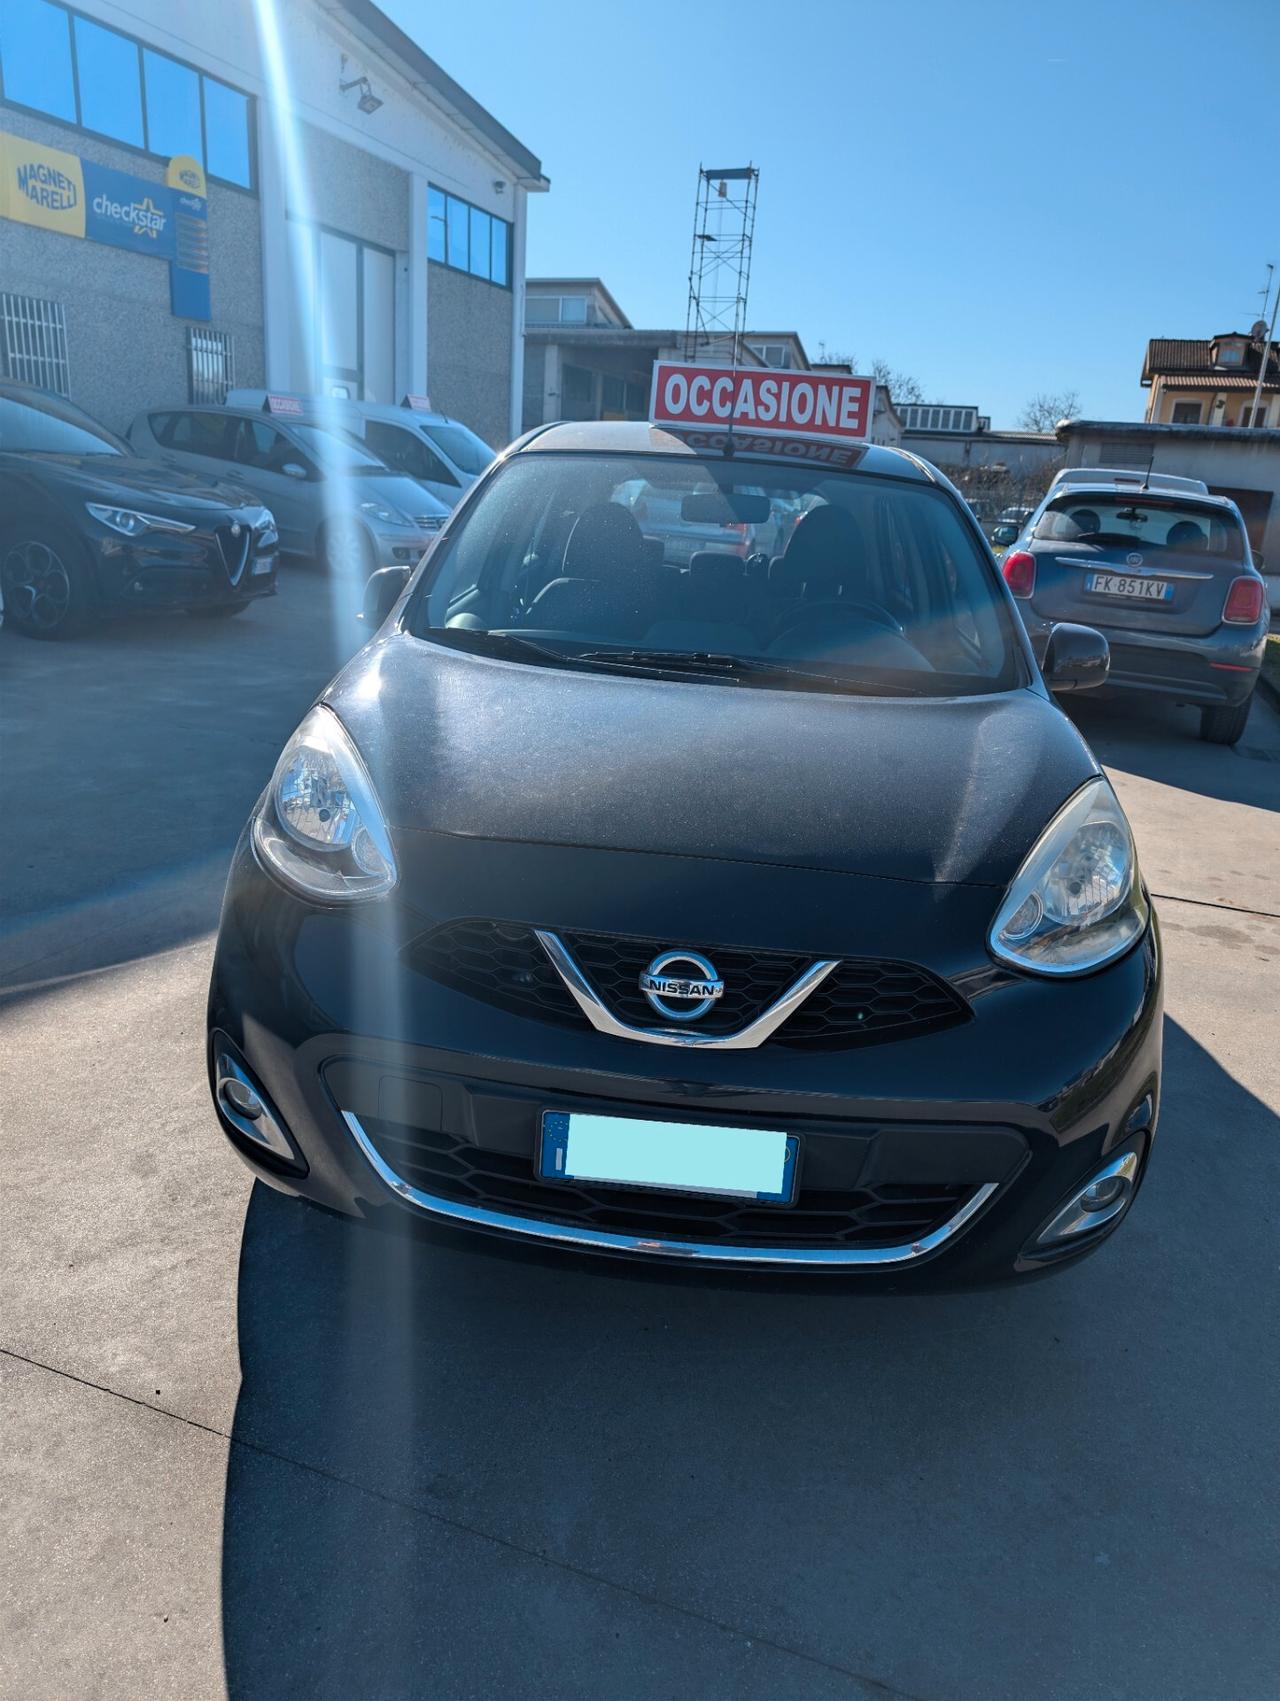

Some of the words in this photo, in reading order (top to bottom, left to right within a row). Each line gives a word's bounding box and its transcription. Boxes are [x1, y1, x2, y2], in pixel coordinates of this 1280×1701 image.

[17, 163, 77, 194] MAGNETI
[18, 177, 77, 210] MARELLI
[93, 193, 167, 231] checkstar
[664, 373, 862, 429] OCCASIONE
[1094, 575, 1114, 592] FK
[1117, 578, 1165, 598] 851KV
[647, 979, 716, 997] NISSAN
